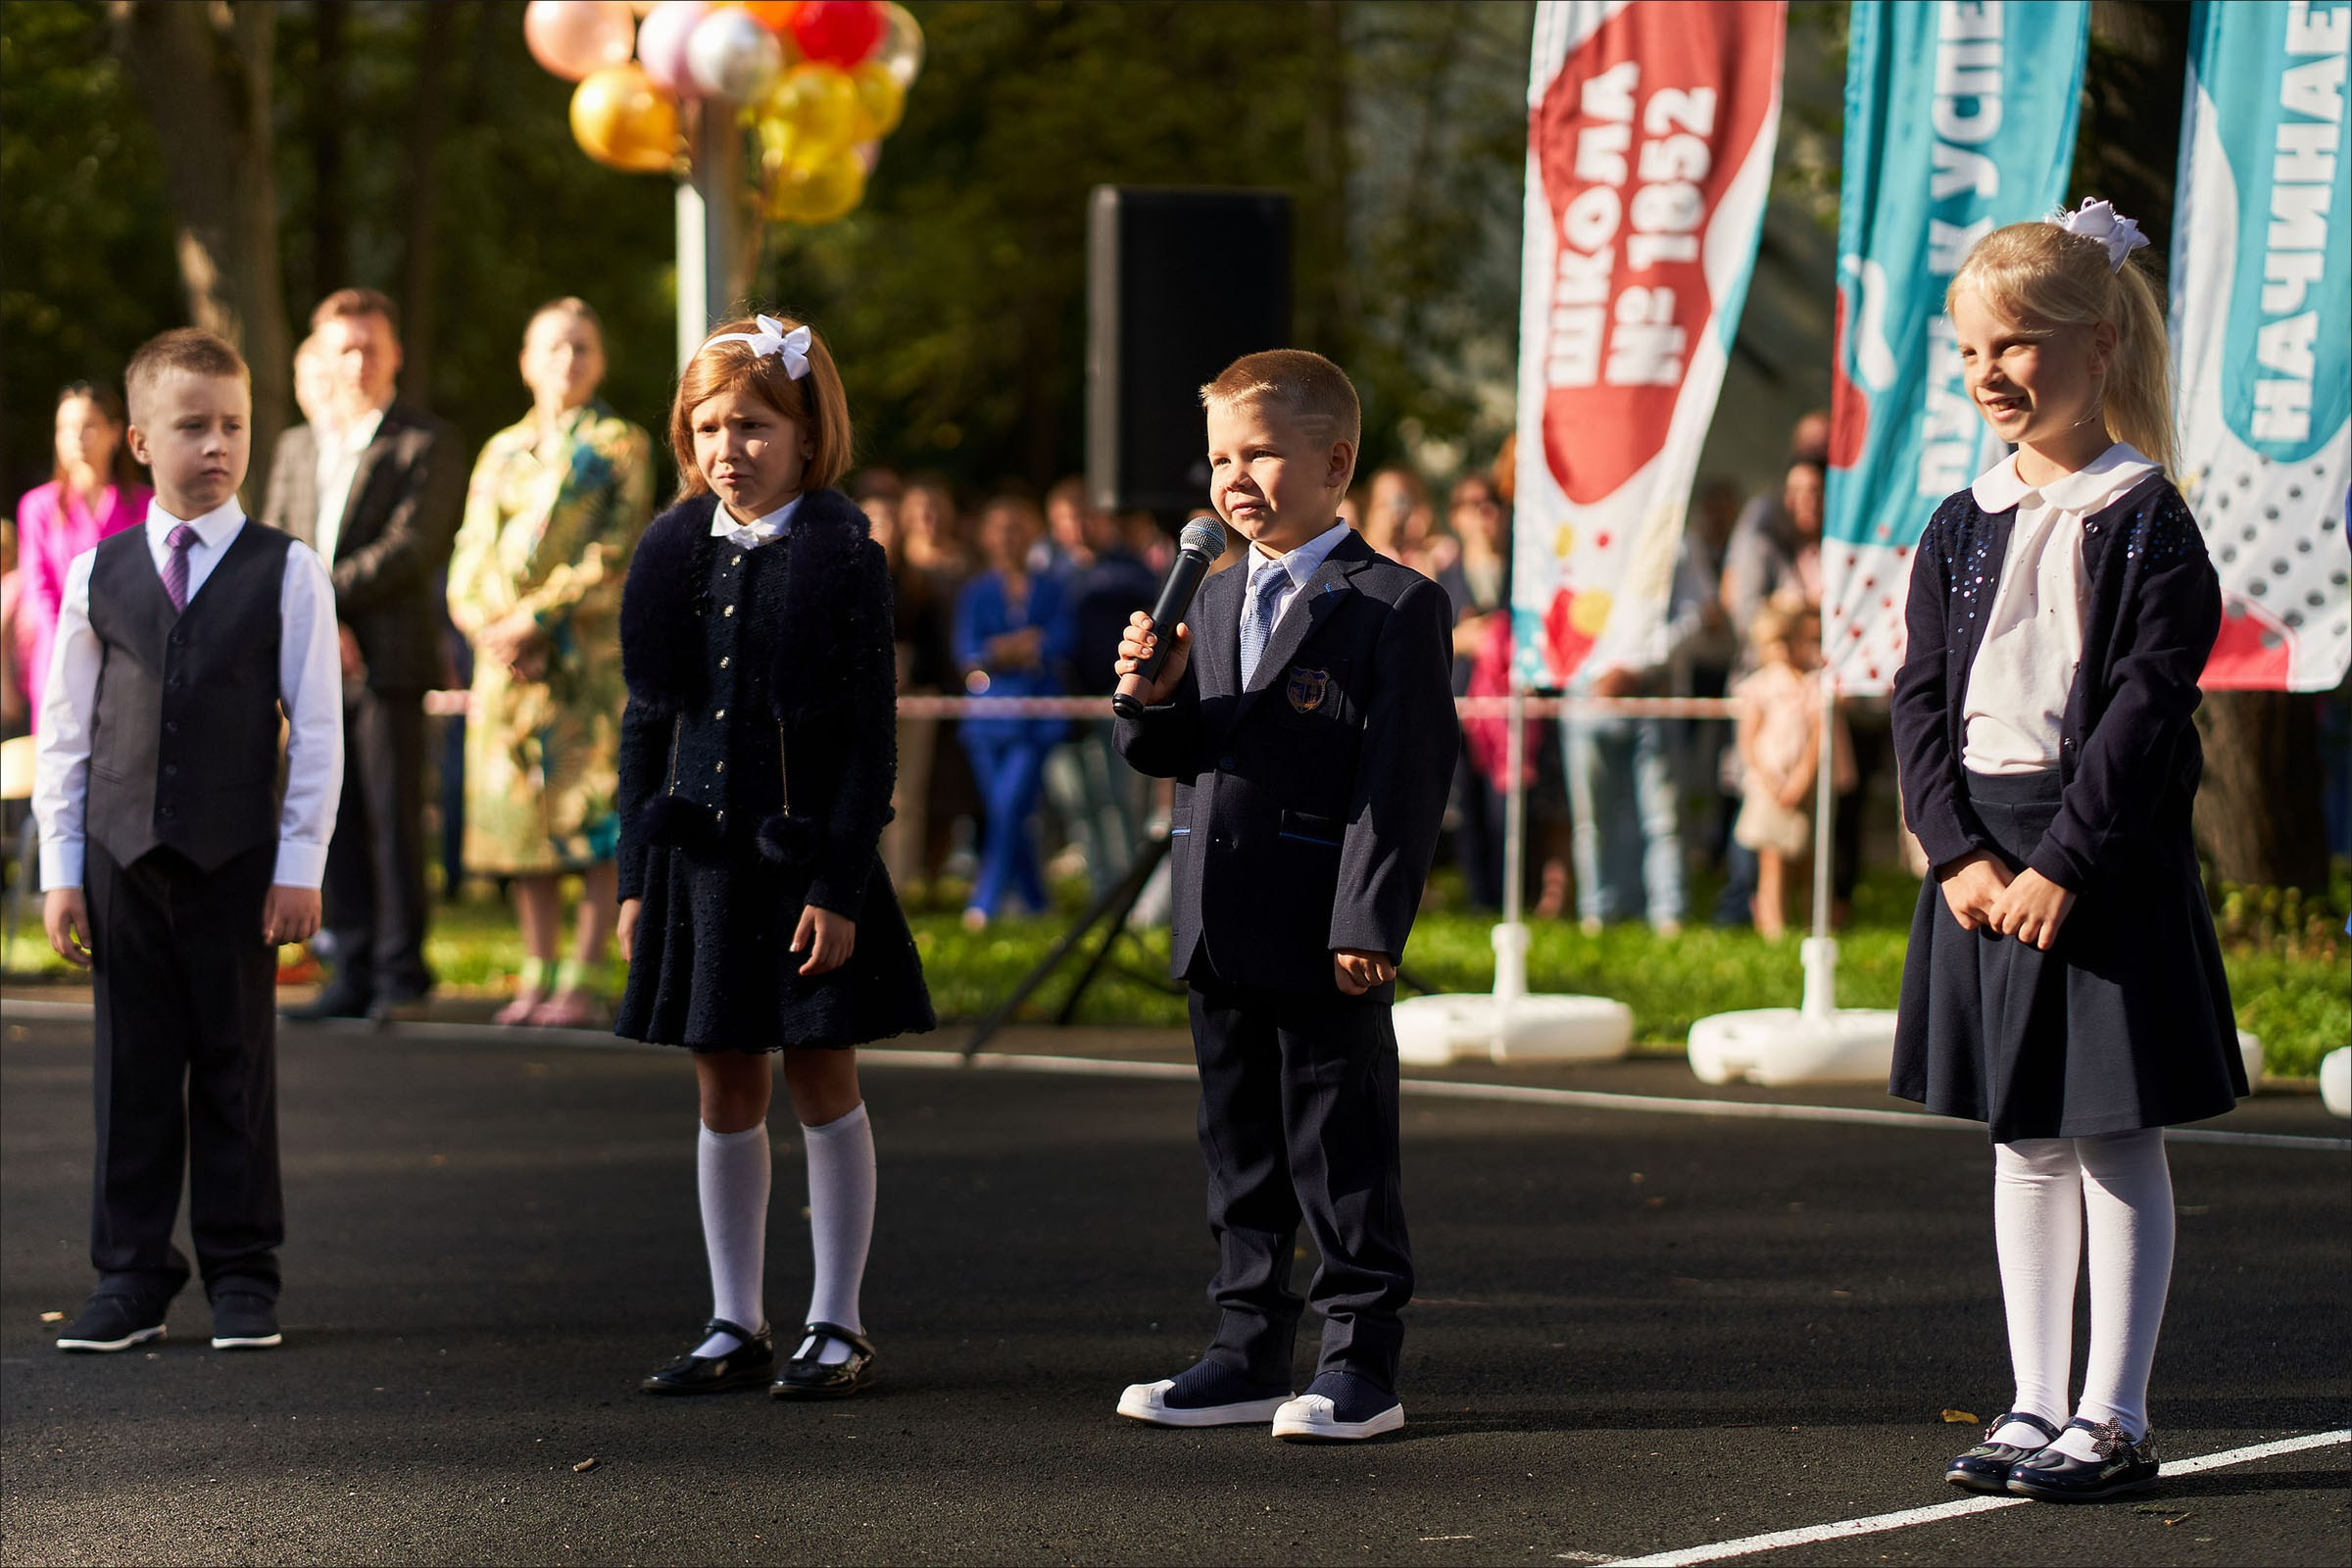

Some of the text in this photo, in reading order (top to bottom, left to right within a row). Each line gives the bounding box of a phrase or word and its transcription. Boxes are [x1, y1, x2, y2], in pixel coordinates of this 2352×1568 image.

[1546, 60, 1641, 387] ШКОЛА
[1604, 85, 1717, 387] № 1852
[1929, 214, 1995, 273] К
[2250, 1, 2350, 441] НАЧИНАЕ
